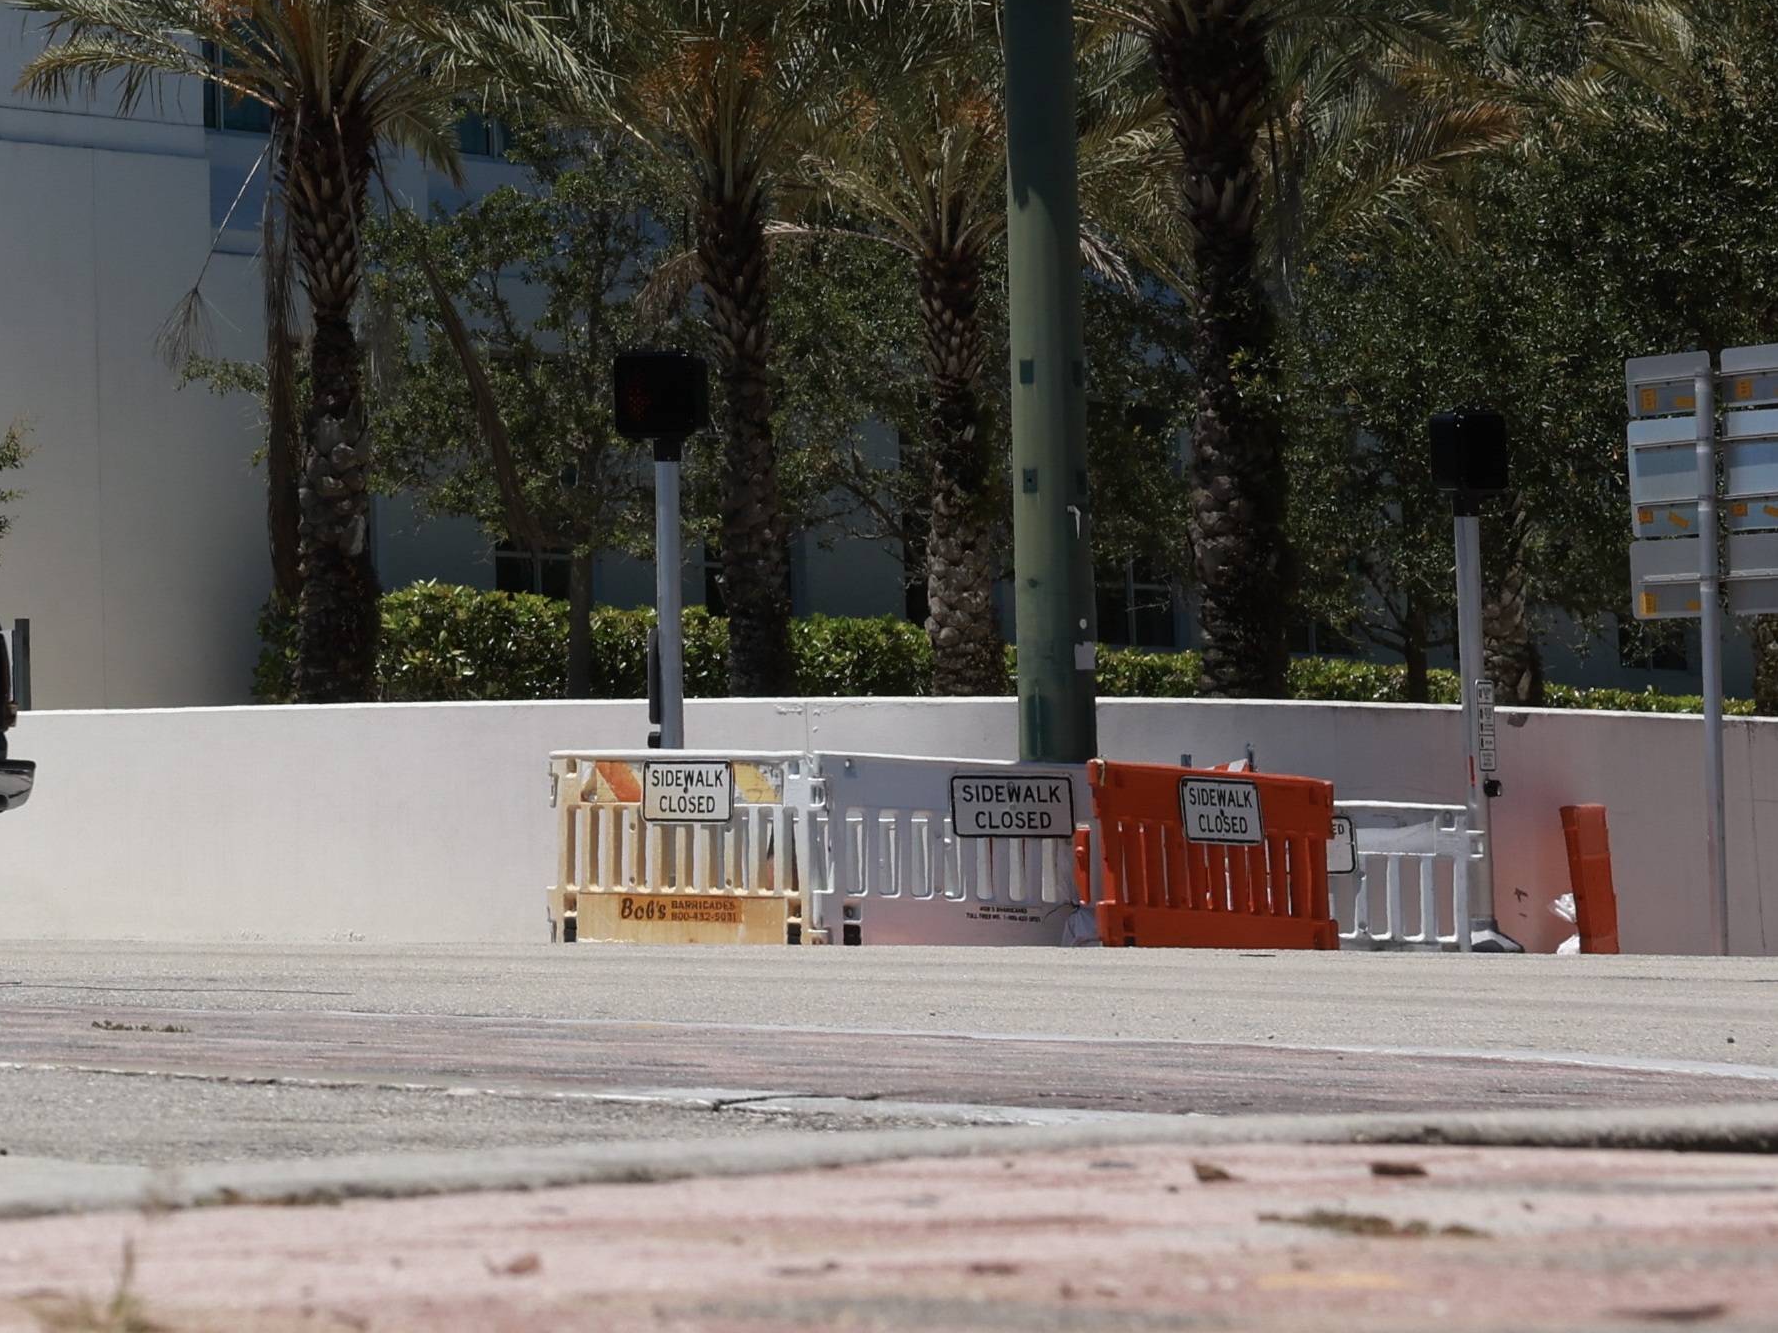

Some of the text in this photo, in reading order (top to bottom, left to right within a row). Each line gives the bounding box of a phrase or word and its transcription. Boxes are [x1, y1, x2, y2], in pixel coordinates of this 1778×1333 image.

[651, 770, 723, 787] SIDEWALK
[962, 785, 1061, 803] SIDEWALK
[1189, 787, 1253, 808] SIDEWALK
[659, 795, 716, 813] CLOSED
[975, 811, 1052, 829] CLOSED
[1199, 813, 1248, 834] CLOSED
[620, 897, 667, 921] Bob's
[671, 900, 736, 910] BARRICADES
